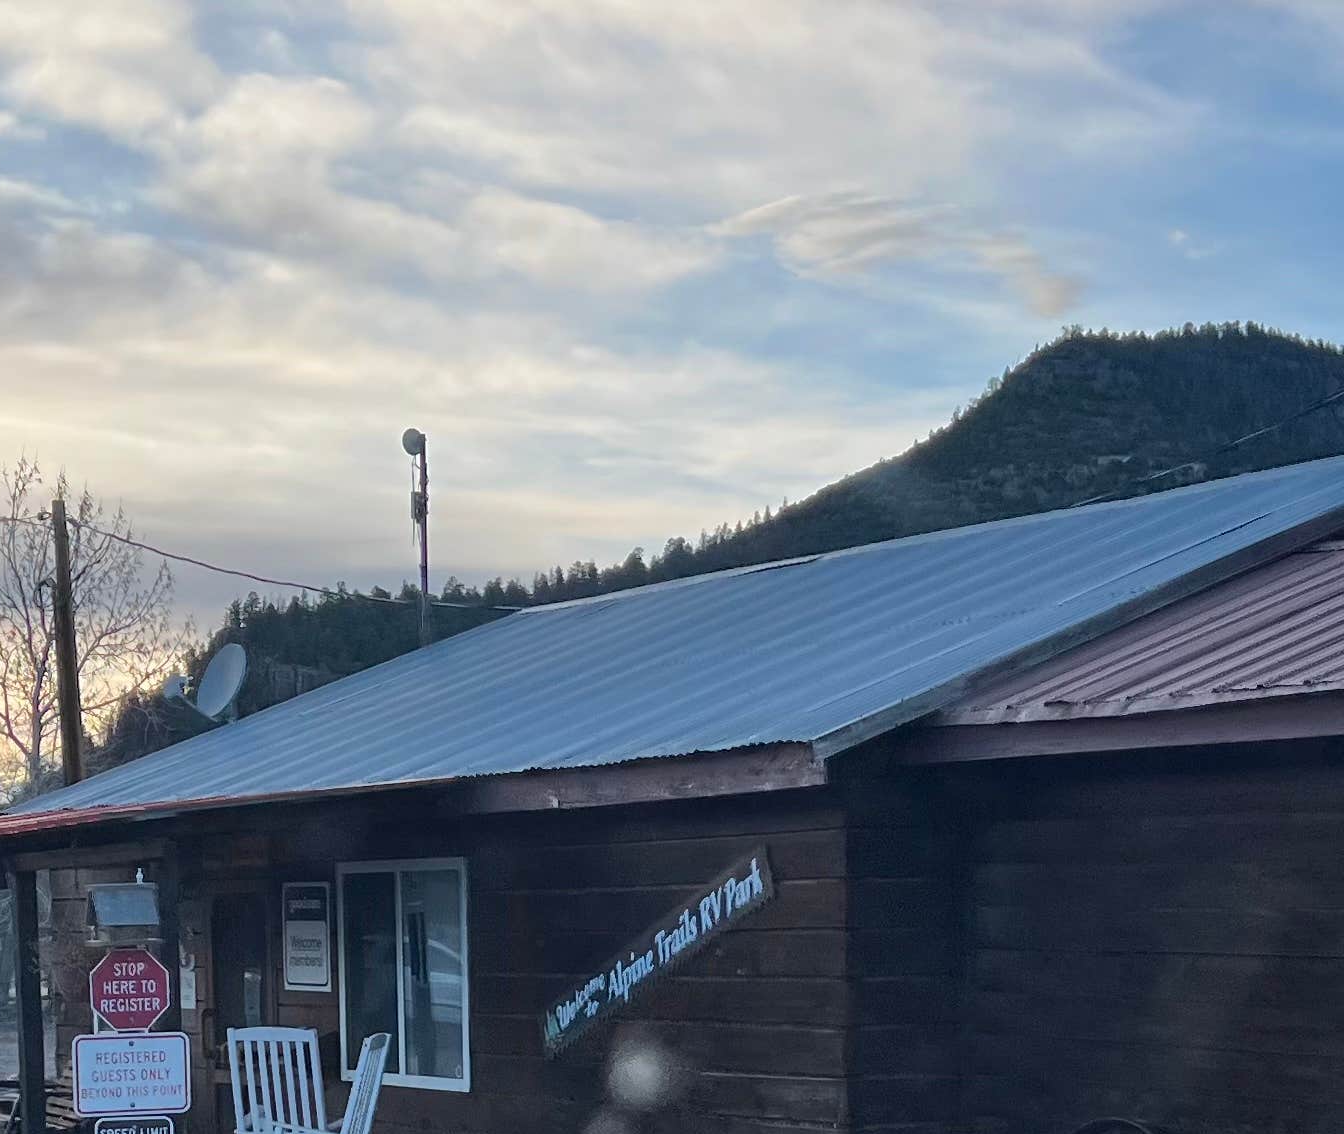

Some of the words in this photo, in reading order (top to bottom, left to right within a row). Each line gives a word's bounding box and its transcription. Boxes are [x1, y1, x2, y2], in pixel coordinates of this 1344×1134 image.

[608, 951, 655, 1003] Alpine
[655, 908, 698, 968] Trails
[699, 885, 723, 934] RV
[724, 857, 764, 918] Park
[113, 963, 145, 977] STOP
[103, 980, 136, 994] HERE
[141, 979, 156, 993] TO
[100, 997, 161, 1013] REGISTER
[556, 973, 605, 1030] Welcome
[95, 1051, 166, 1065] REGISTERED
[91, 1068, 136, 1082] GUESTS
[141, 1068, 171, 1080] ONLY
[80, 1086, 123, 1099] BEYOND
[127, 1085, 149, 1098] THIS
[152, 1084, 183, 1096] POINT
